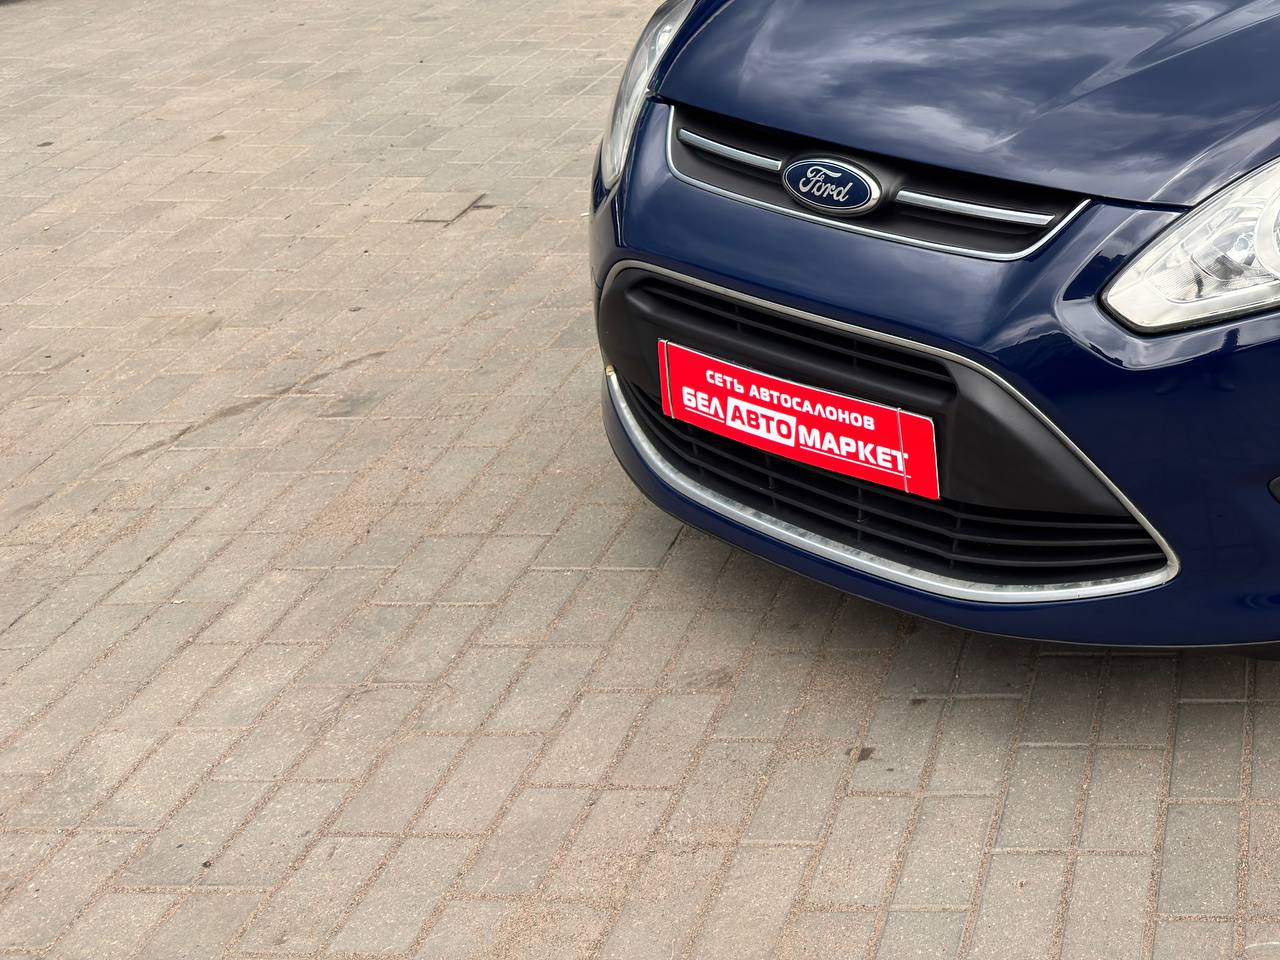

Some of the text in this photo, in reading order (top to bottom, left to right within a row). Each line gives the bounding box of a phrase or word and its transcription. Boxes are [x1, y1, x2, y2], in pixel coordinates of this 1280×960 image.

[799, 166, 853, 202] Ford
[705, 369, 876, 431] СЕТЬ АВТОСАЛОНОВ
